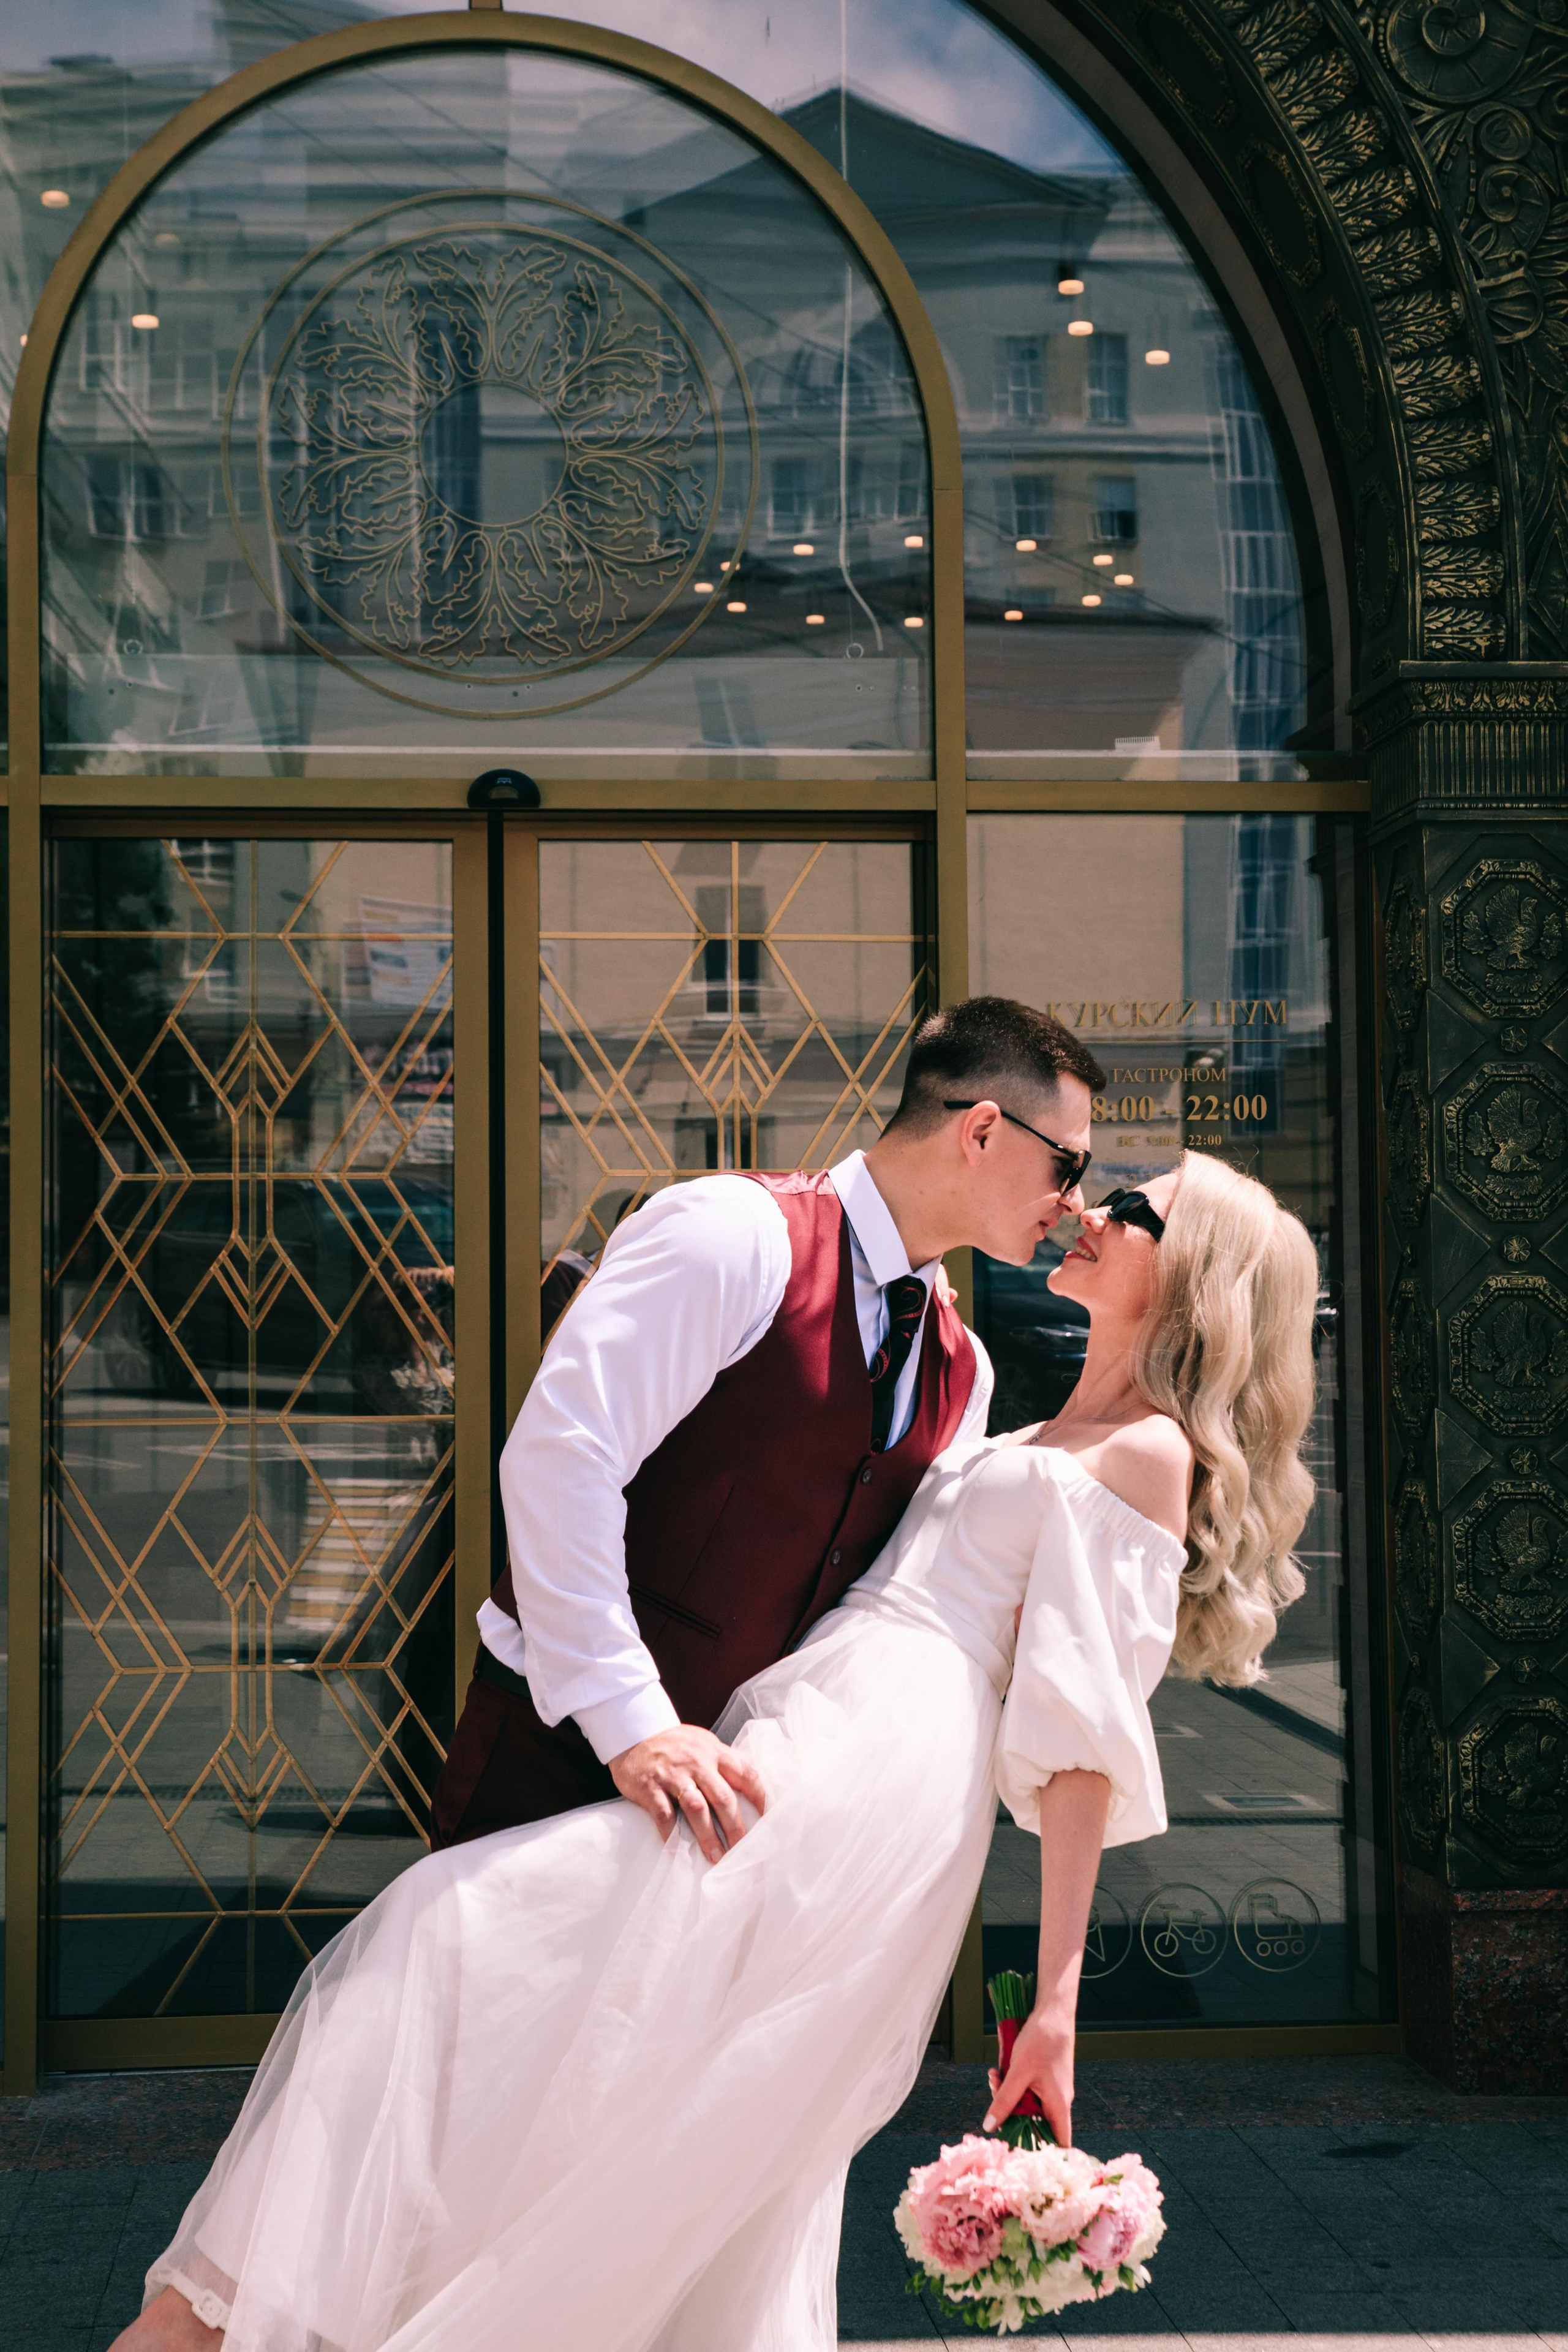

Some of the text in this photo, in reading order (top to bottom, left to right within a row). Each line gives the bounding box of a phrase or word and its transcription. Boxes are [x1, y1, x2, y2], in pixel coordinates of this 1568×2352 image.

[1048, 998, 1287, 1027] КУРСКИЙ ЦУМ
[1113, 1068, 1226, 1082] ГАСТРОНОМ
[1091, 1095, 1155, 1122] 8:00
[1186, 1095, 1267, 1120] 22:00
[1188, 1134, 1222, 1145] 22:00
